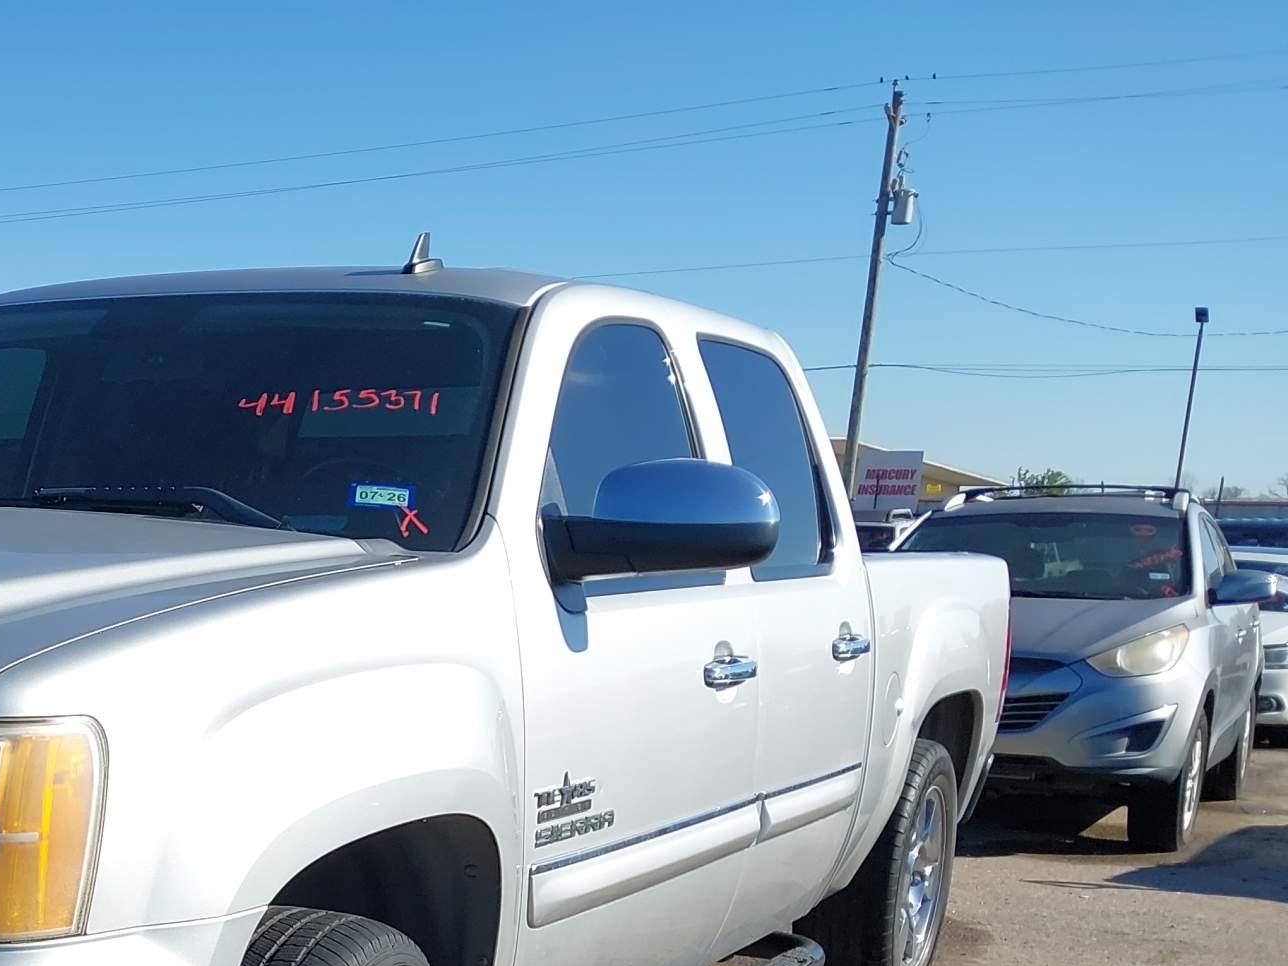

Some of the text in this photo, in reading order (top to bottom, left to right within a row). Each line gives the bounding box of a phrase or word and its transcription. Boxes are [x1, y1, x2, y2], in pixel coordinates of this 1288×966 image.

[865, 468, 917, 480] MERCURY
[857, 484, 918, 496] INSURANCE
[534, 808, 615, 849] SIERRA
